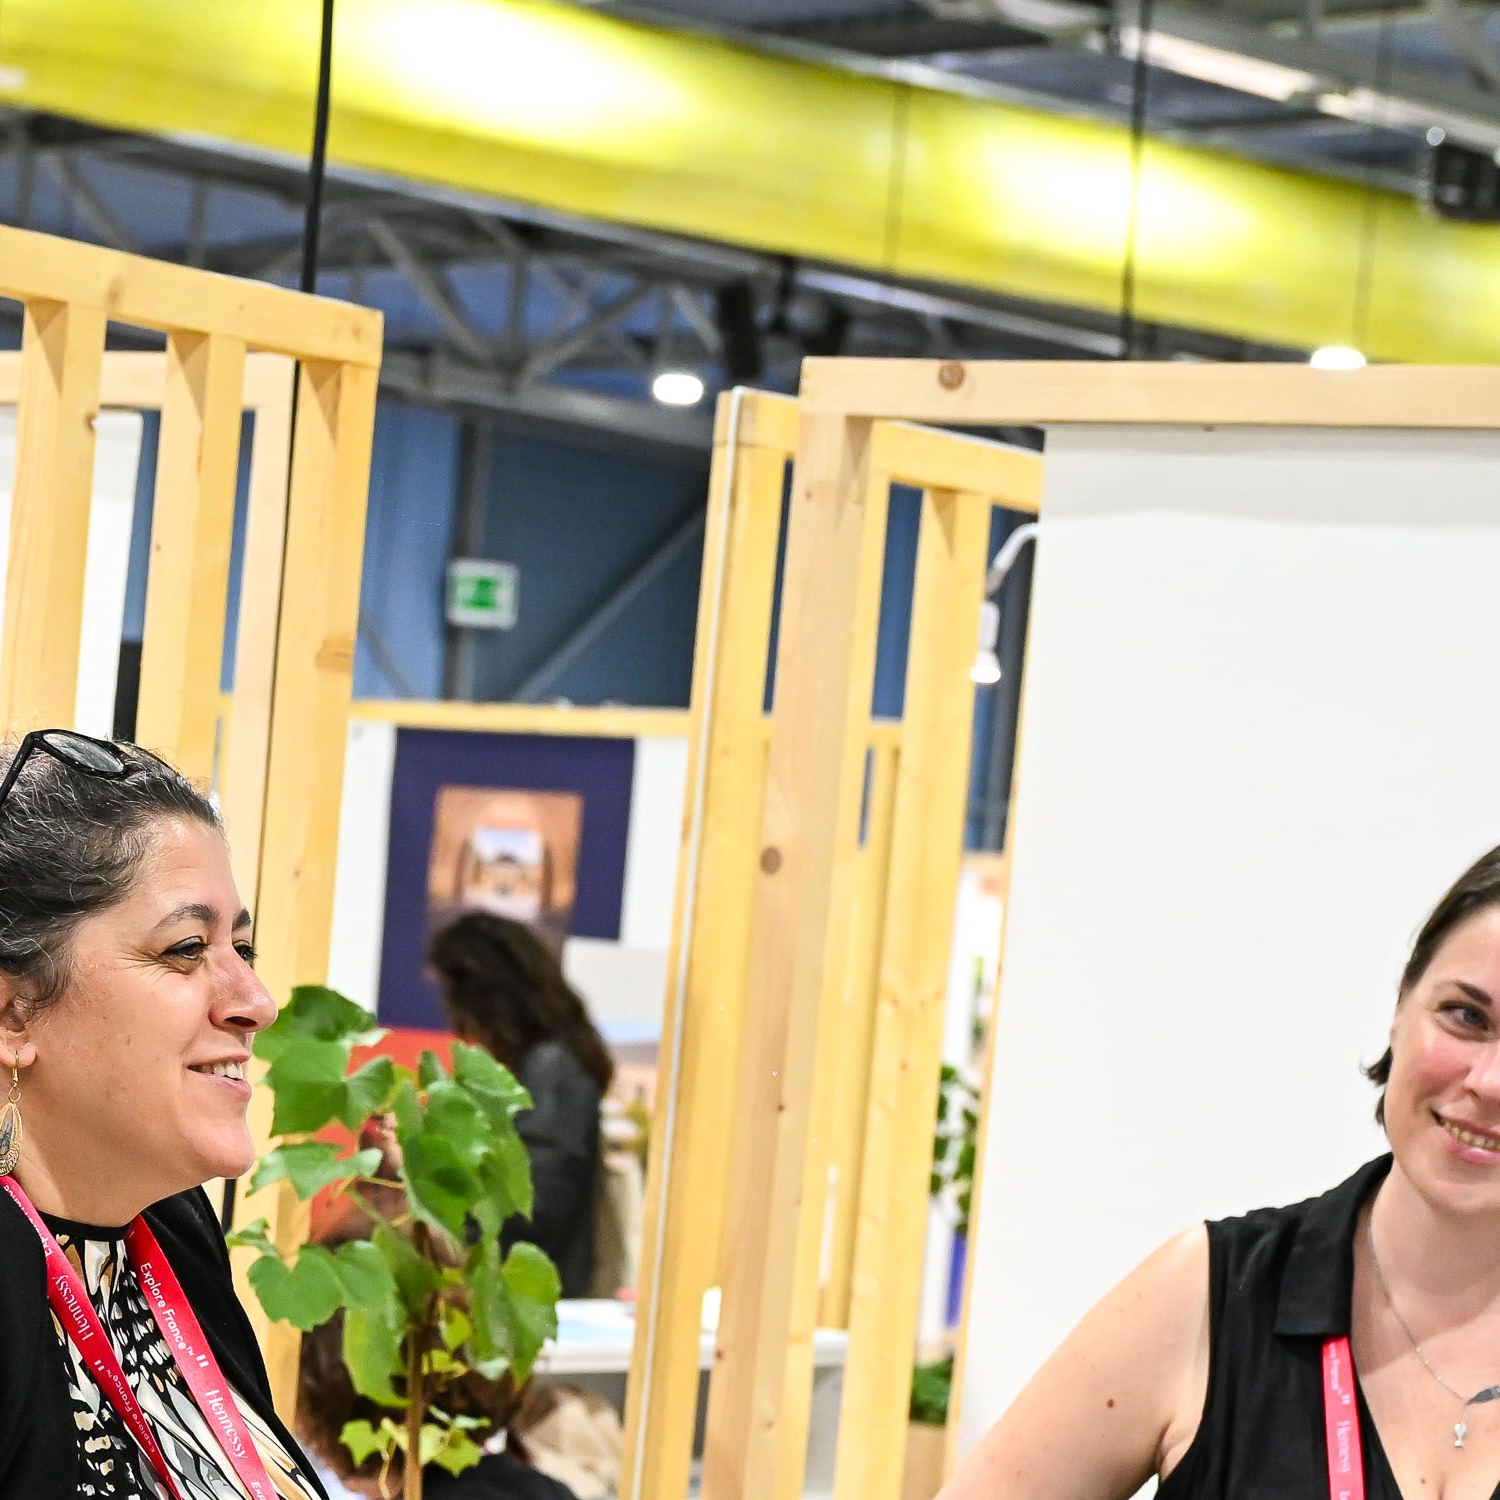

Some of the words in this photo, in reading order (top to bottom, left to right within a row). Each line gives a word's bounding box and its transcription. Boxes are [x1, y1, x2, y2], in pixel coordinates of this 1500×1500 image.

[53, 1274, 95, 1341] Hennessy
[140, 1262, 167, 1309] Explore
[131, 1412, 156, 1453] Explore
[204, 1388, 249, 1460] Hennessy
